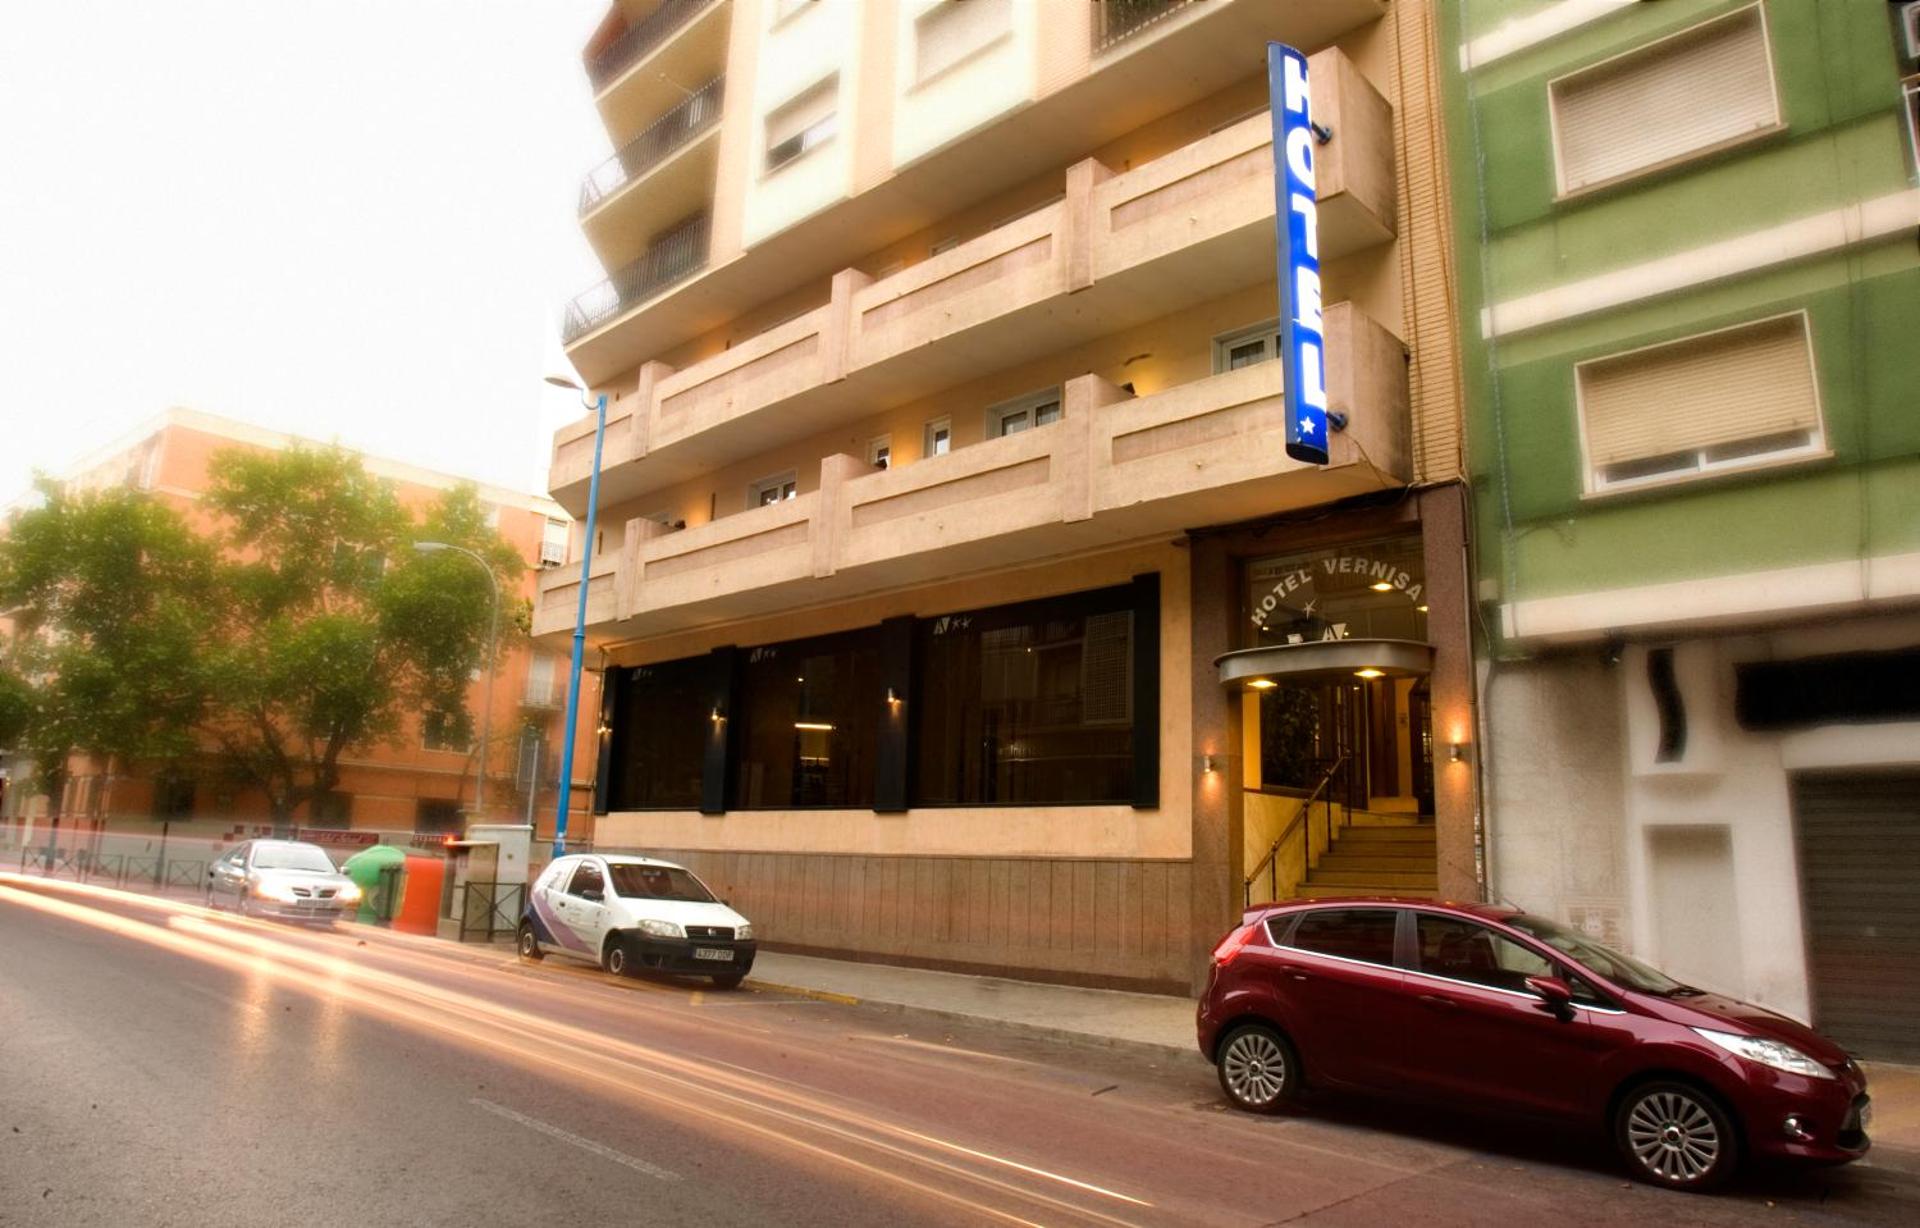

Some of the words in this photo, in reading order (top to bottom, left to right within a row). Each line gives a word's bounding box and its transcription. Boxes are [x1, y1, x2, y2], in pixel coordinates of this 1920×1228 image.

[1284, 55, 1328, 412] HOTEL
[1250, 569, 1313, 626] HOTEL
[1324, 557, 1424, 602] VERNISA
